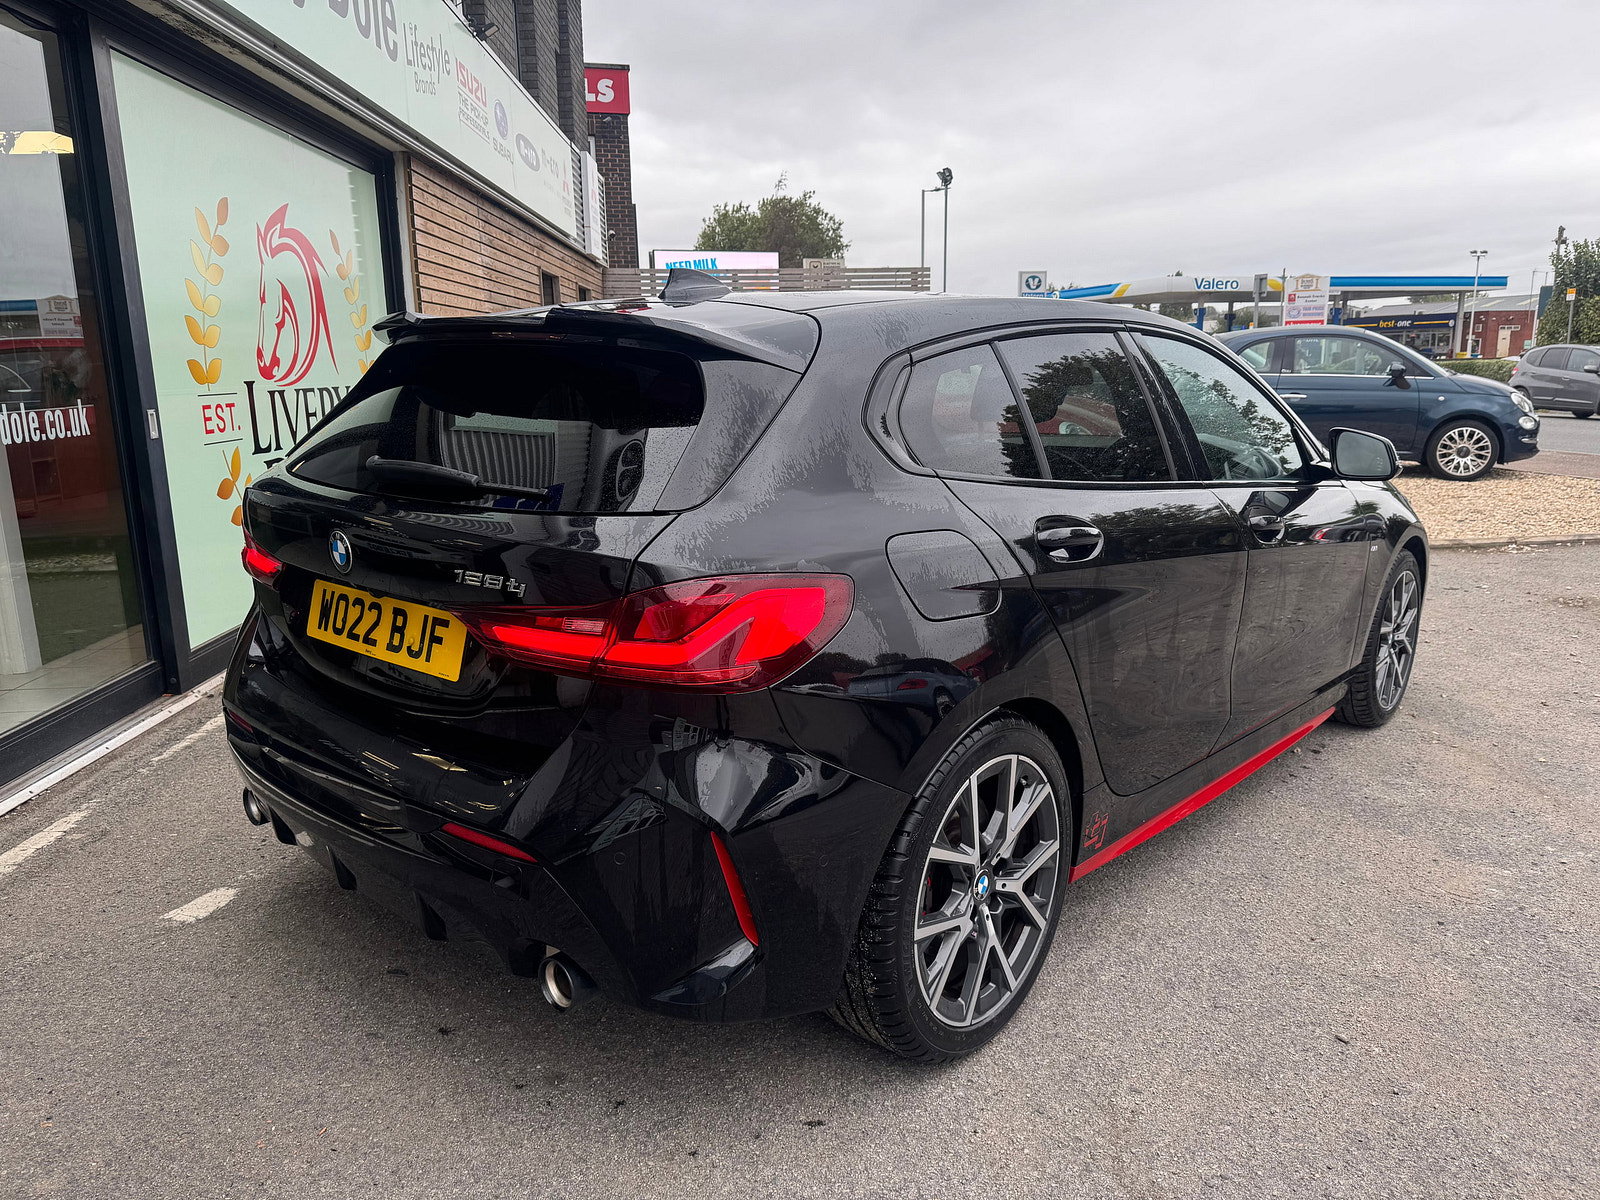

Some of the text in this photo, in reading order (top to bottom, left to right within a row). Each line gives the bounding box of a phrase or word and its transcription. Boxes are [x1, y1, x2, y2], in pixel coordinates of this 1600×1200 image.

[402, 22, 451, 84] Lifestyle
[414, 71, 437, 96] Brands
[455, 57, 487, 108] ISUZU
[693, 258, 718, 270] MILK
[1194, 277, 1240, 291] Valero
[1379, 320, 1412, 328] best-one
[0, 398, 91, 446] dole.co.uk
[201, 402, 242, 435] EST.
[385, 606, 451, 663] BJF
